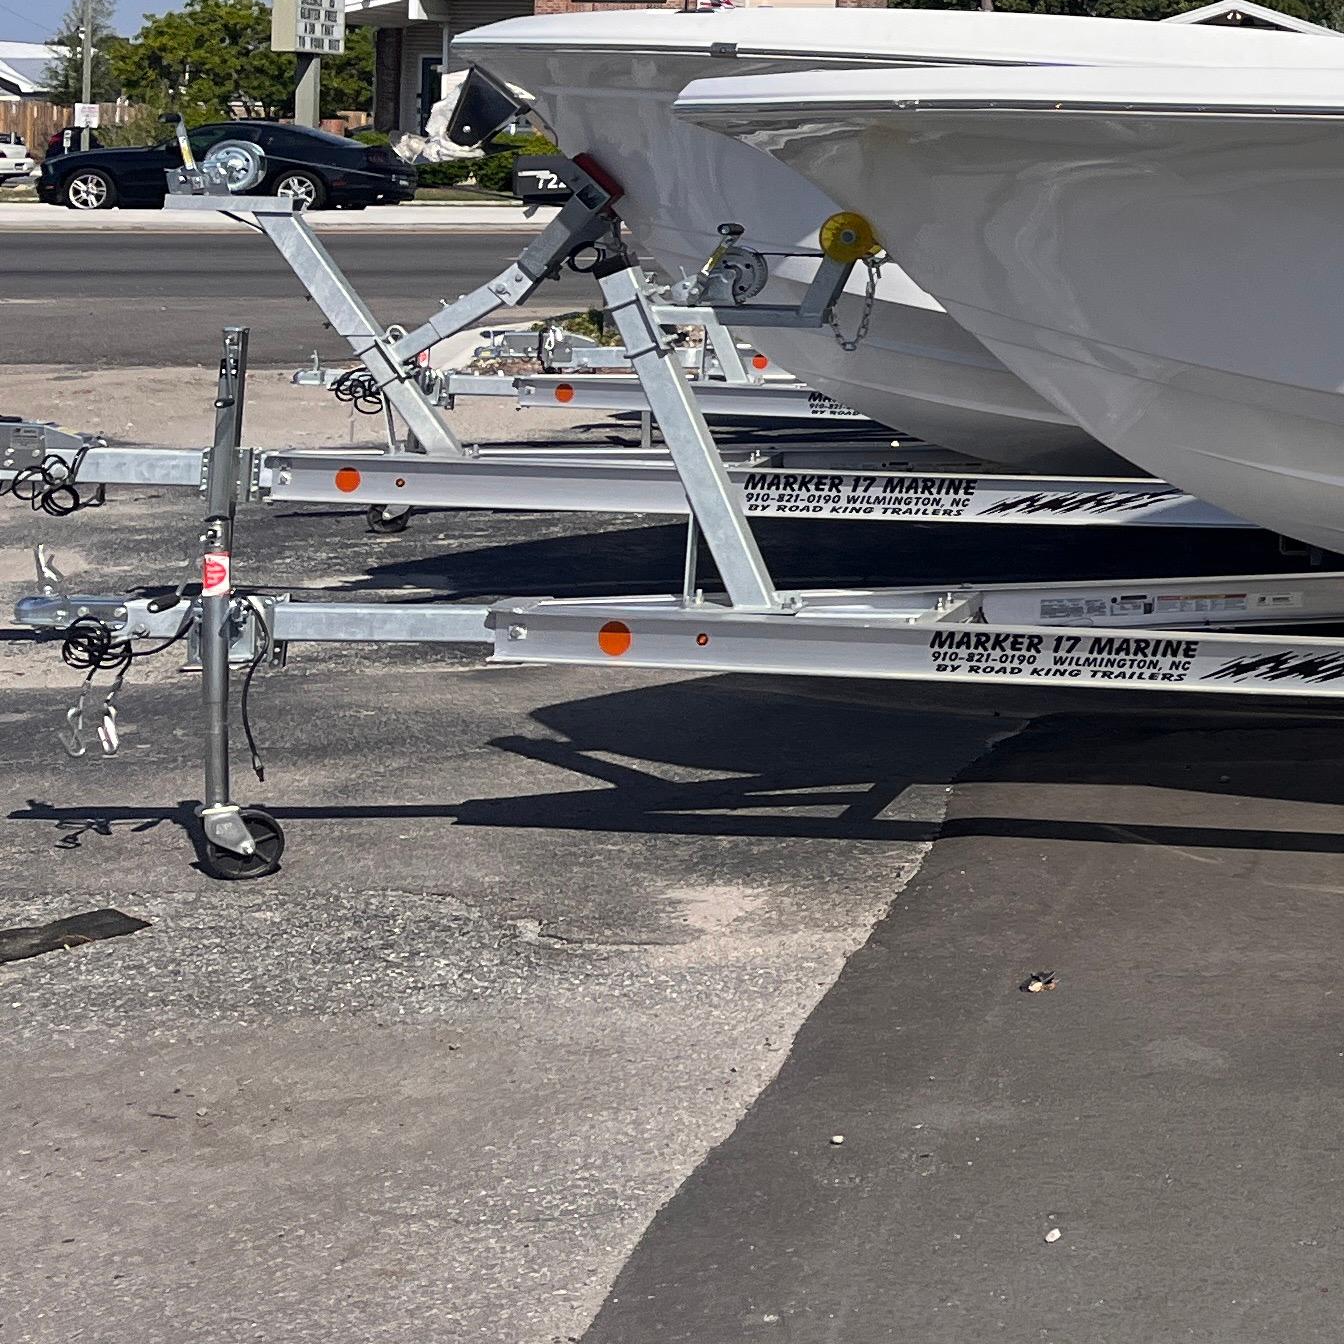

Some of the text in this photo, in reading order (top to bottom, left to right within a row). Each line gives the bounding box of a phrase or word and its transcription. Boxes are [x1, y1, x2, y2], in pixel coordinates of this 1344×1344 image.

[744, 473, 978, 496] MARKER 17 MARINE
[745, 493, 970, 508] 910-821-0190 WILMINGTON, NC
[748, 504, 964, 517] BY ROAD KING TRAILERS
[930, 631, 1199, 658] MARKER 17 MARINE
[932, 651, 1191, 672] 910-821-0190 WILMINGTON, NC
[935, 664, 1187, 682] BY ROAD KING TRAILERS
